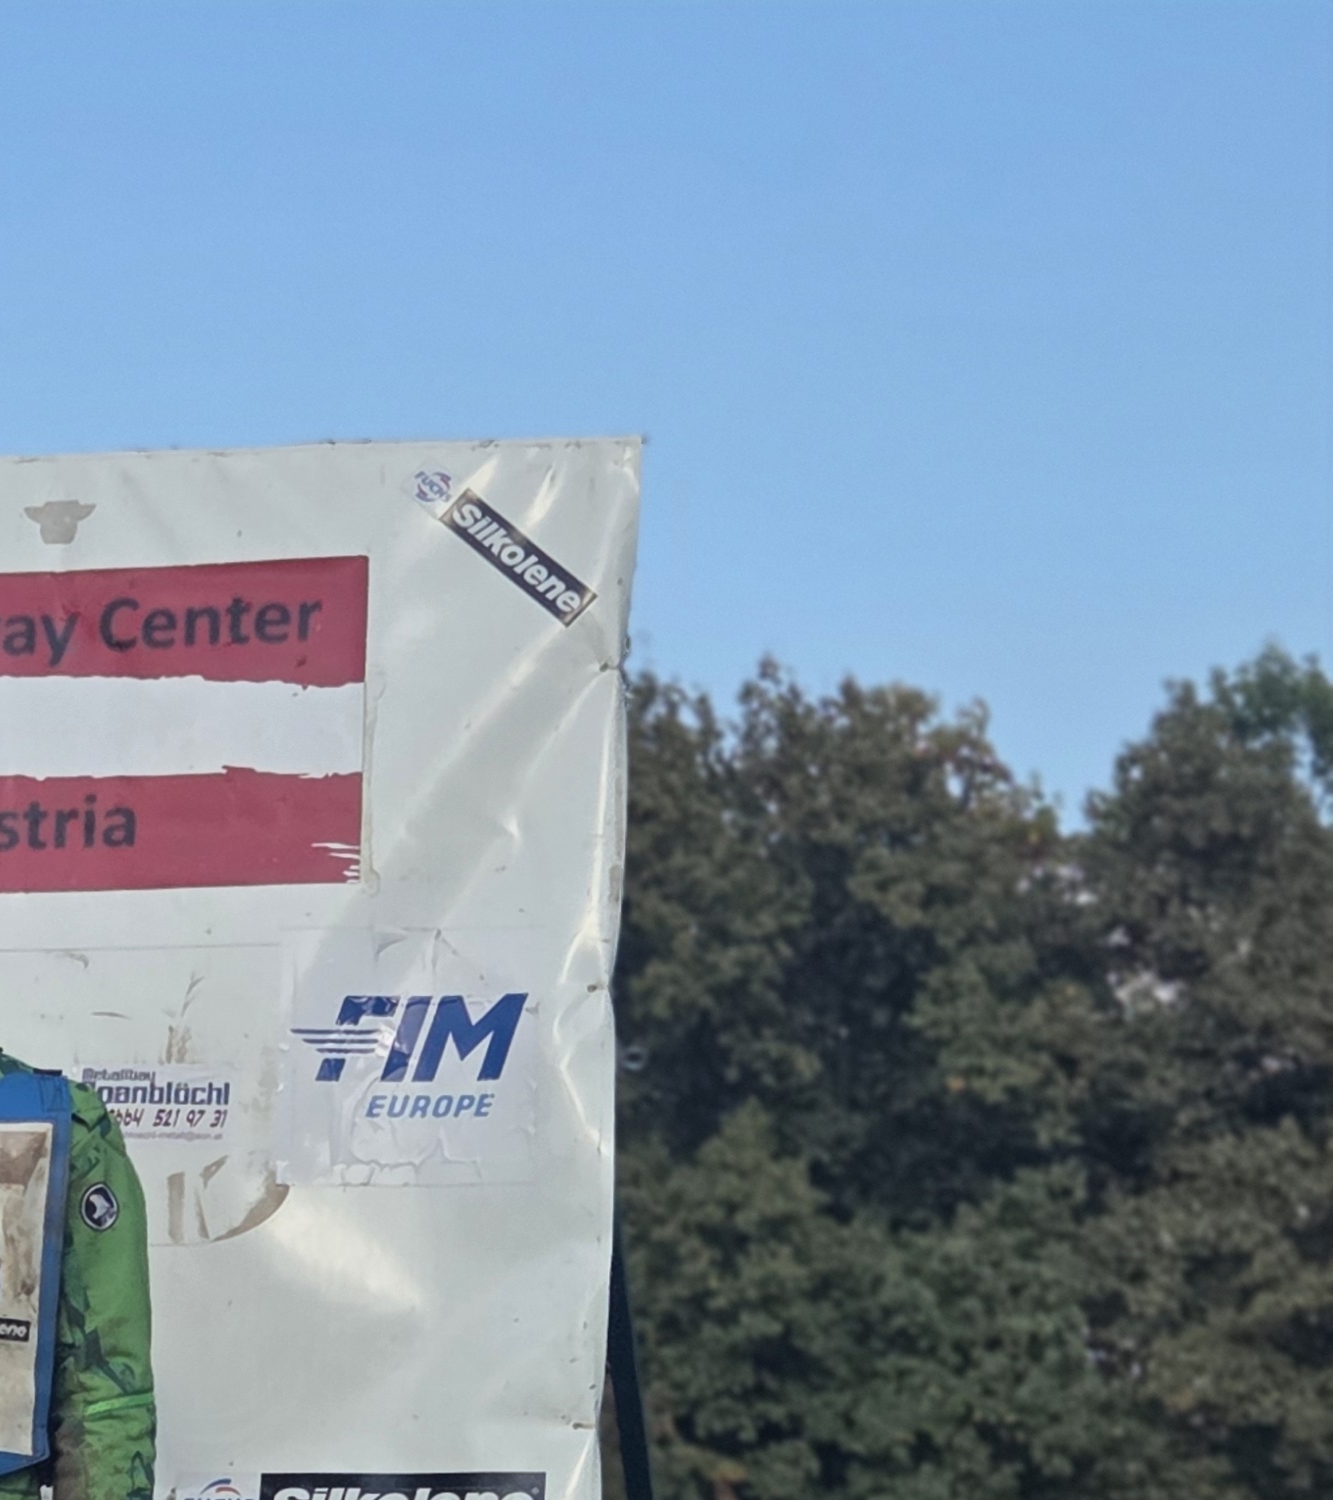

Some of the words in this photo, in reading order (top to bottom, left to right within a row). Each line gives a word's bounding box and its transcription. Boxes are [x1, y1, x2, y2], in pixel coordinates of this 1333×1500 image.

[452, 503, 581, 613] Silkolene
[98, 594, 323, 653] Center
[290, 993, 529, 1082] FIM
[85, 1082, 230, 1105] panblöchl
[366, 1094, 496, 1119] EUROPE
[152, 1109, 180, 1127] 521
[186, 1109, 206, 1128] 97
[210, 1110, 228, 1128] 31
